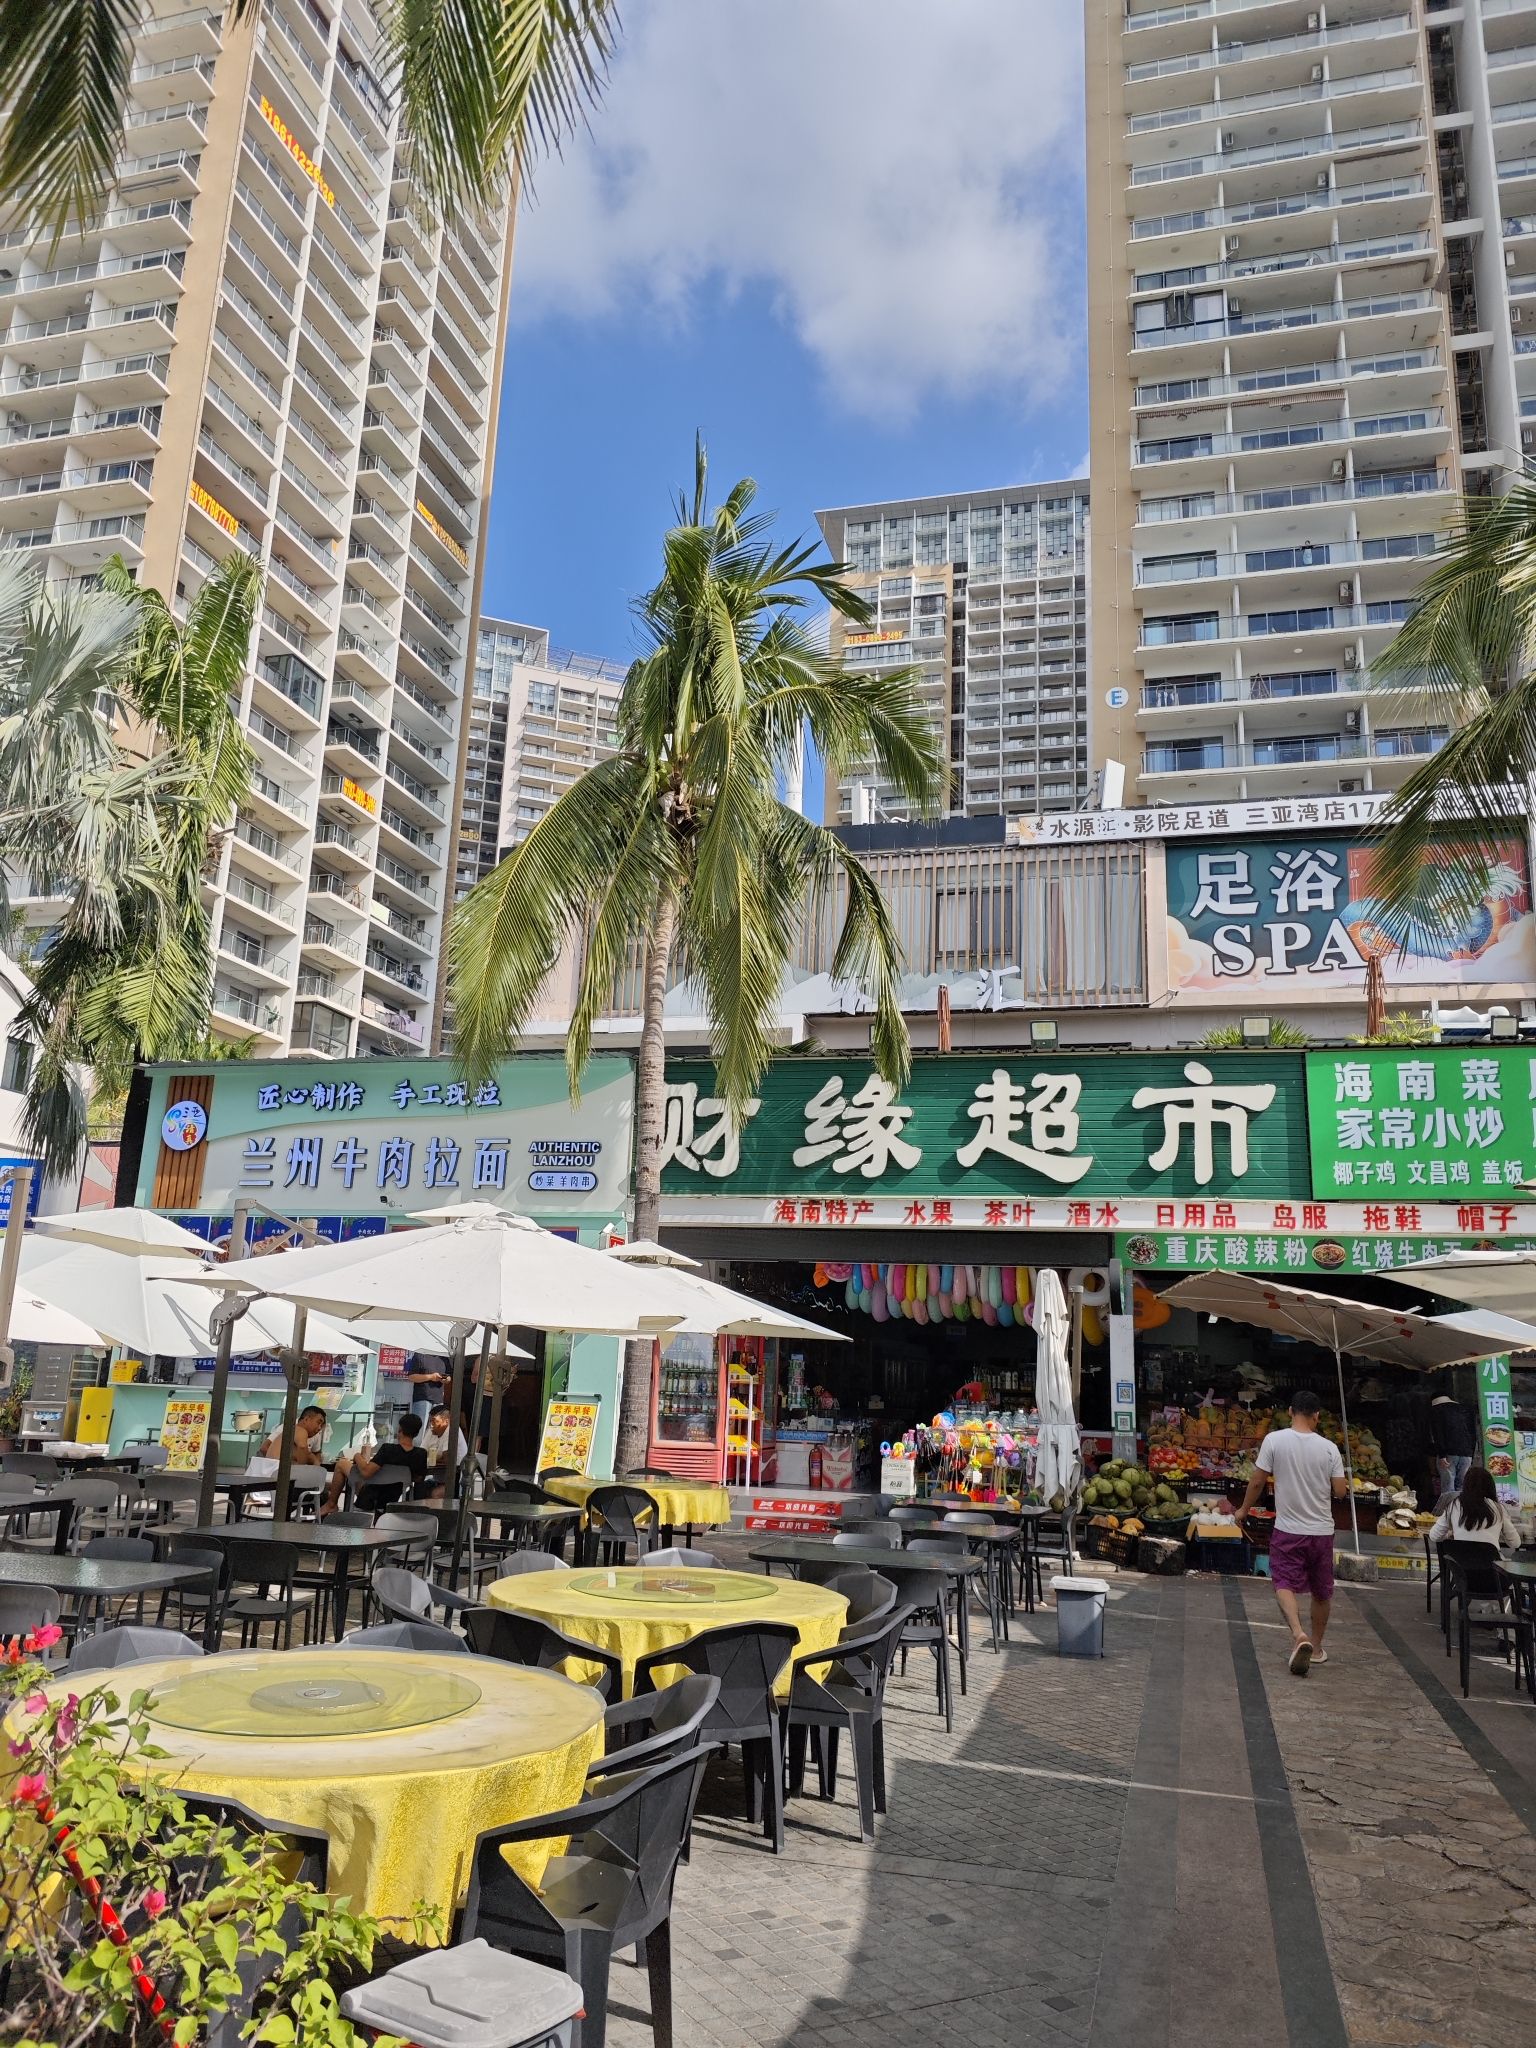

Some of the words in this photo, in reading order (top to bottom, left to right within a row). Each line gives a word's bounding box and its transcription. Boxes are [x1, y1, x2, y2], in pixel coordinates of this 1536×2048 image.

[1111, 690, 1123, 706] E
[1189, 849, 1343, 919] 足浴
[1212, 917, 1369, 977] SPA
[257, 1082, 364, 1111] 匠心制作
[388, 1078, 502, 1109] 手工现拉
[1334, 1059, 1503, 1102] 海南菜
[1336, 1106, 1505, 1149] 家常小炒
[238, 1136, 512, 1190] 兰州牛肉拉面
[528, 1141, 601, 1155] AUTHENTIC
[532, 1155, 597, 1168] LANZHOU
[1333, 1160, 1396, 1185] 椰子鸡
[1408, 1160, 1470, 1186] 文昌鸡
[1482, 1159, 1524, 1185] 盖饭
[773, 1200, 874, 1224] 海南特产
[903, 1200, 954, 1225] 水果
[984, 1201, 1036, 1227] 茶叶
[1067, 1201, 1119, 1228] 酒水
[1156, 1204, 1237, 1229] 日用品
[1273, 1204, 1328, 1230] 岛服
[1363, 1206, 1423, 1232] 拖鞋
[1457, 1205, 1518, 1232] 帽子
[1165, 1236, 1309, 1267] 重庆酸辣粉
[1482, 1356, 1510, 1421] 小面
